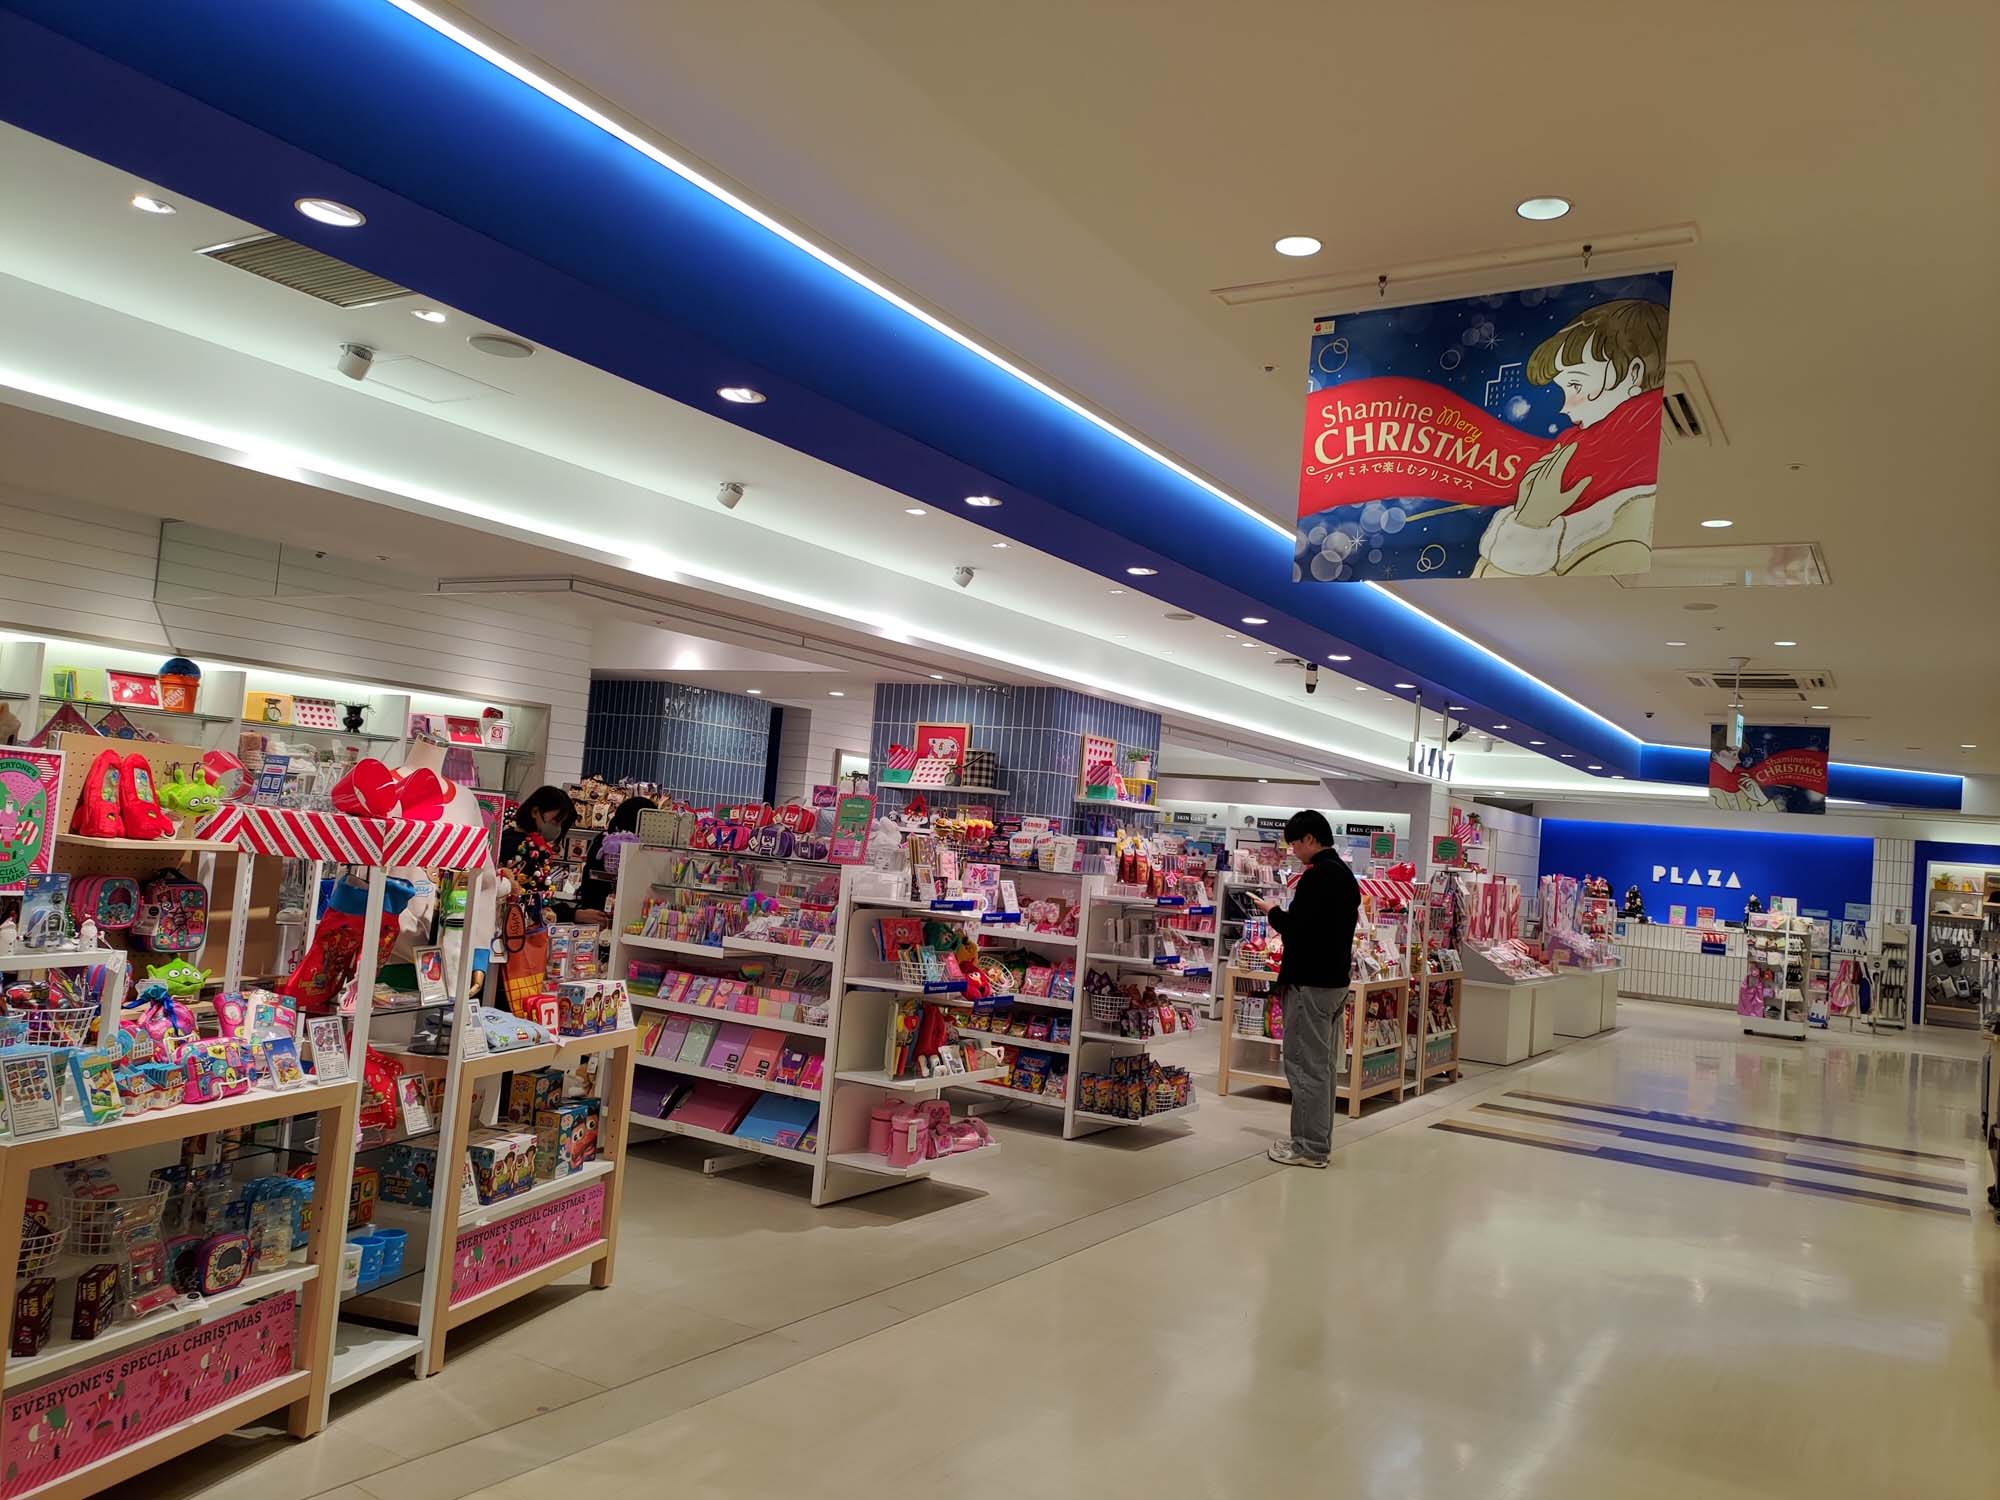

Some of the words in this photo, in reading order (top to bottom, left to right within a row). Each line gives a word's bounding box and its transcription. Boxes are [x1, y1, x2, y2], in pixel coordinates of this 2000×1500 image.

[1322, 395, 1433, 428] Shamine
[1436, 405, 1483, 444] Merry
[1315, 421, 1521, 481] CHRISTMAS
[1324, 461, 1474, 490] シャミネで楽しむクリスマス
[0, 761, 38, 777] ERYONE'S
[1755, 764, 1824, 782] CHRISTMAS
[1652, 864, 1742, 889] PLAZA
[455, 1225, 507, 1252] EVERYONE'S
[509, 1213, 541, 1231] SPECIAL
[542, 1194, 586, 1218] CHRISTMAS
[12, 1368, 115, 1422] EVERYONE'S
[119, 1344, 182, 1377] SPECIAL
[182, 1310, 263, 1354] CHRISTMAS
[266, 1298, 294, 1320] 2025
